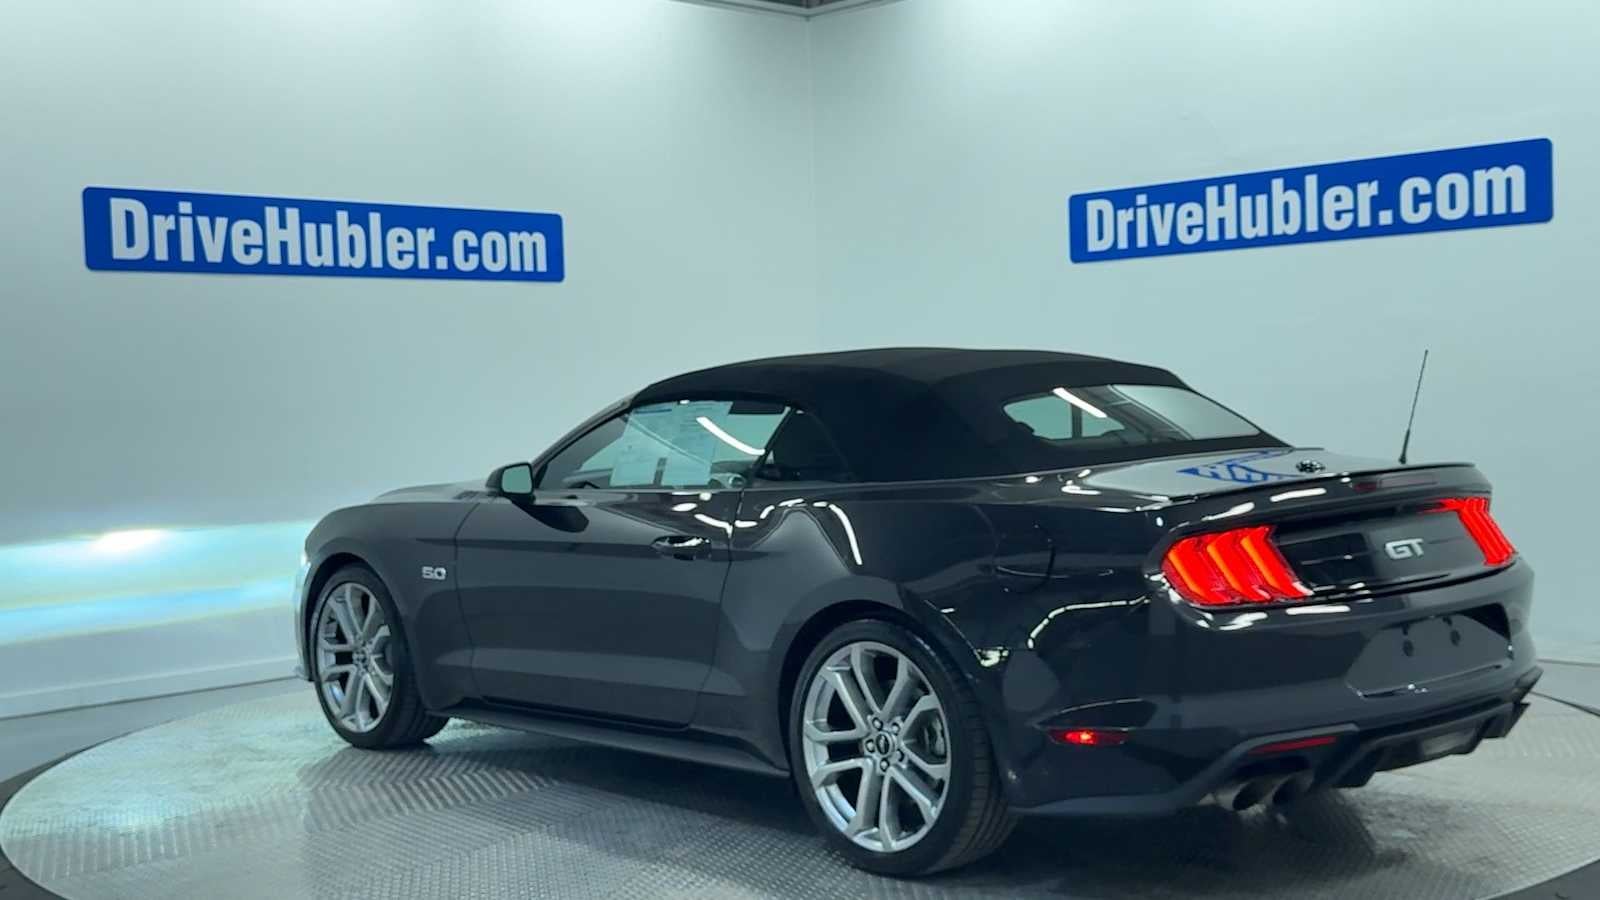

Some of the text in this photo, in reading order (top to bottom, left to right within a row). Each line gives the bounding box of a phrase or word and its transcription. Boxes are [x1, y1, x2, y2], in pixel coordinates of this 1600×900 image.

[109, 197, 547, 273] DriveHubler.com
[1086, 163, 1526, 252] DriveHubler.com
[1384, 538, 1424, 560] GT
